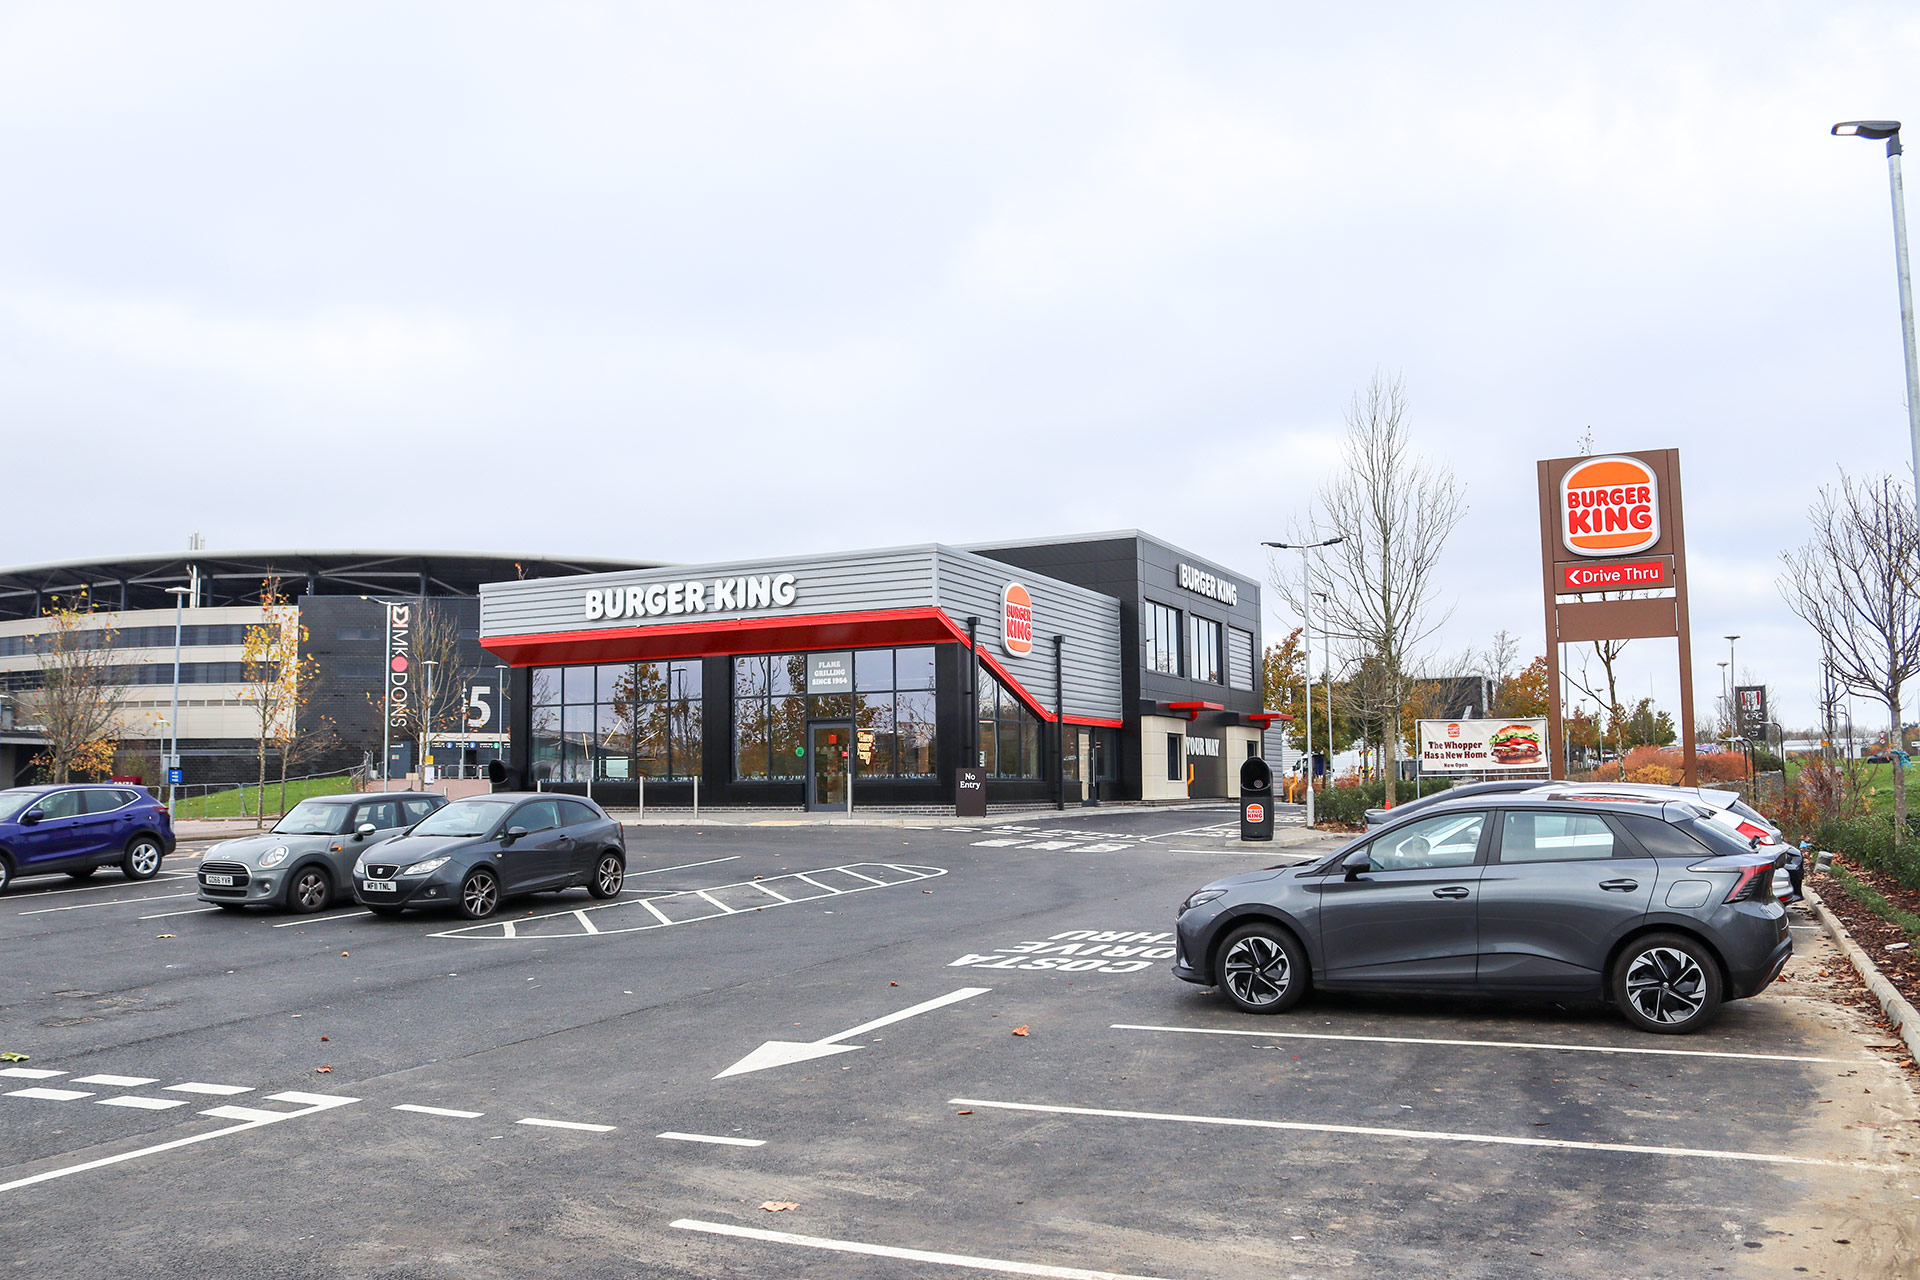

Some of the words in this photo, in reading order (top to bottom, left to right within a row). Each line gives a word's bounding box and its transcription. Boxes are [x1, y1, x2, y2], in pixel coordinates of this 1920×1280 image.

[1567, 486, 1651, 509] BURGER
[1568, 504, 1652, 535] KING
[1179, 563, 1217, 599] BURGER
[1217, 578, 1237, 606] KING
[1582, 569, 1621, 583] Drive
[1623, 567, 1659, 581] Thru
[585, 581, 706, 620] BURGER
[714, 573, 796, 611] KING
[1006, 603, 1032, 622] BURGER
[1006, 618, 1032, 641] KING
[814, 669, 846, 677] GRILLING
[818, 660, 841, 669] FLAME
[812, 678, 832, 686] SINCE
[832, 677, 848, 685] 1954
[390, 672, 408, 728] DONS
[467, 686, 491, 728] 5
[1186, 736, 1205, 756] YOUR
[1205, 738, 1220, 757] WAY
[1428, 741, 1443, 749] The
[1444, 741, 1482, 750] Whopper
[1464, 751, 1487, 759] Home
[959, 781, 981, 790] Entry
[964, 772, 976, 781] No
[993, 941, 1177, 959] DRIVE
[947, 953, 1154, 973] COSTA
